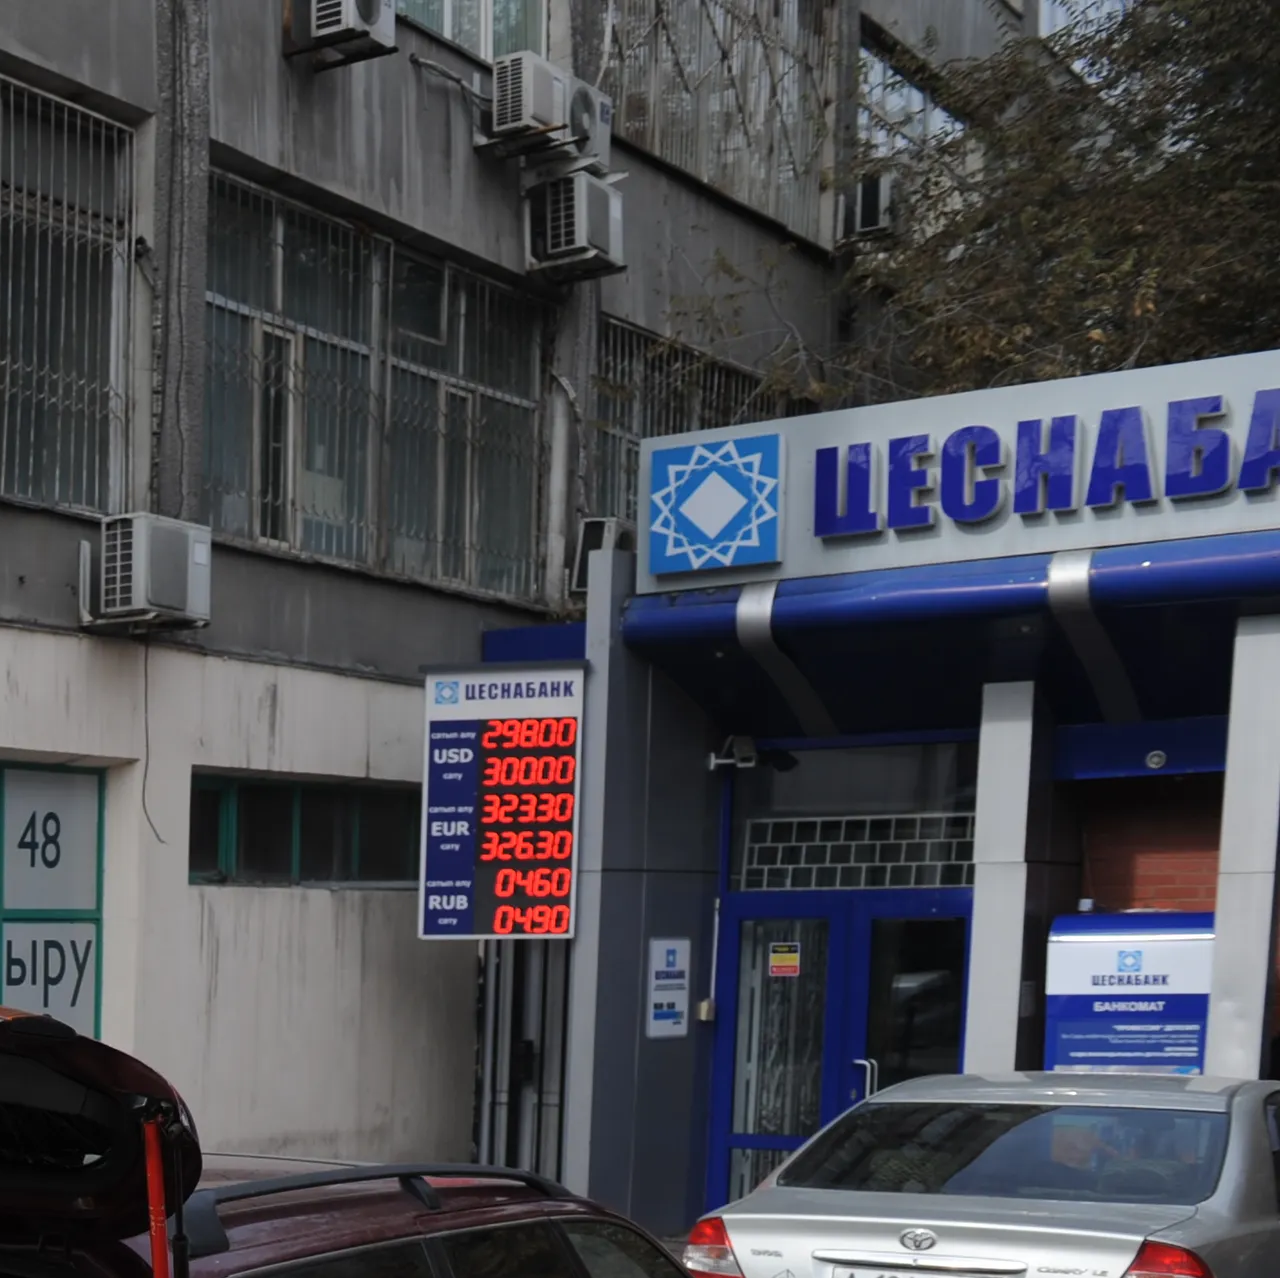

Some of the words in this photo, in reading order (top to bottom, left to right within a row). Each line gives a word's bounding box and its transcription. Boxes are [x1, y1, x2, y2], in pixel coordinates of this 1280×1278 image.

[465, 680, 575, 701] ЦЕСНАБАНК
[433, 748, 474, 764] USD
[430, 821, 471, 837] EUR
[17, 811, 61, 869] 48
[428, 895, 469, 910] RUB
[1091, 974, 1170, 986] ЦЕСНАБАНК
[1093, 1001, 1166, 1013] БАНКОМАТ
